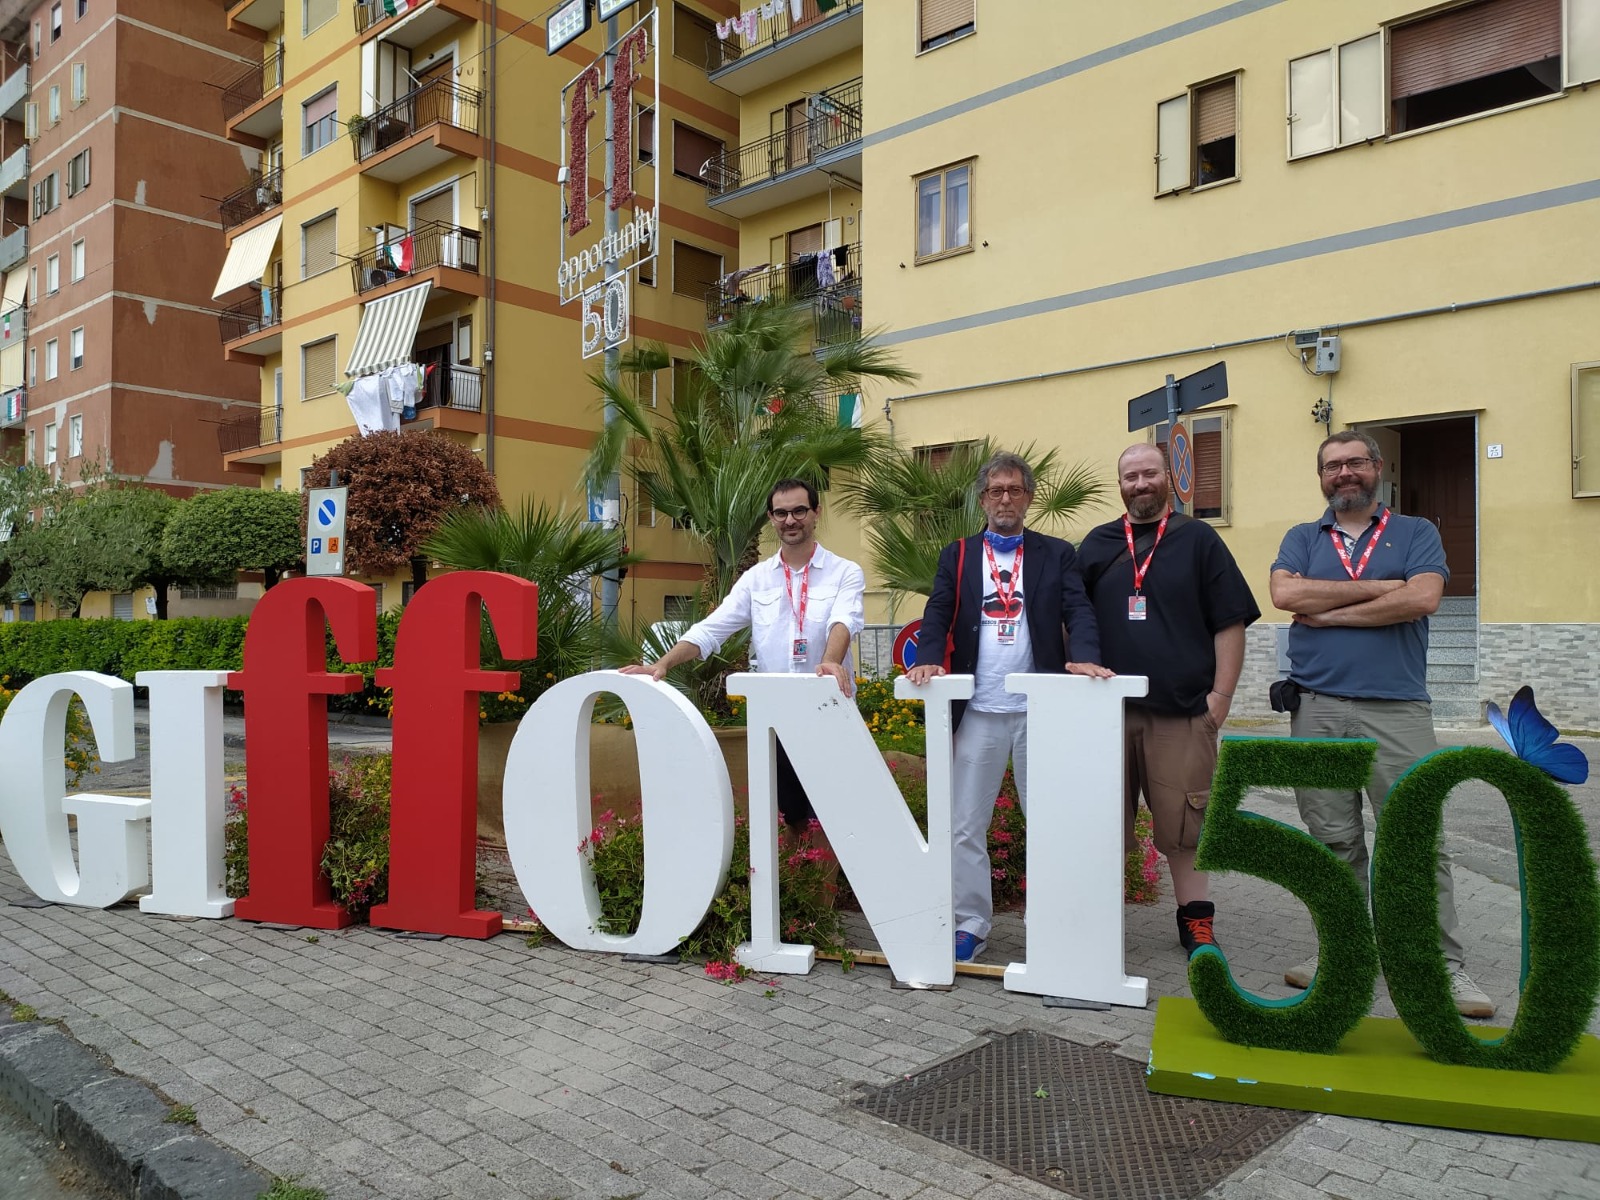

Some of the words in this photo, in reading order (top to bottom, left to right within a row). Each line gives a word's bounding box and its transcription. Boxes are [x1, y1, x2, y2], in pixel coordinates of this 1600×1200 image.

[558, 206, 657, 297] opportunity
[583, 279, 626, 353] 50
[312, 539, 320, 553] P
[1187, 735, 1600, 1073] 50
